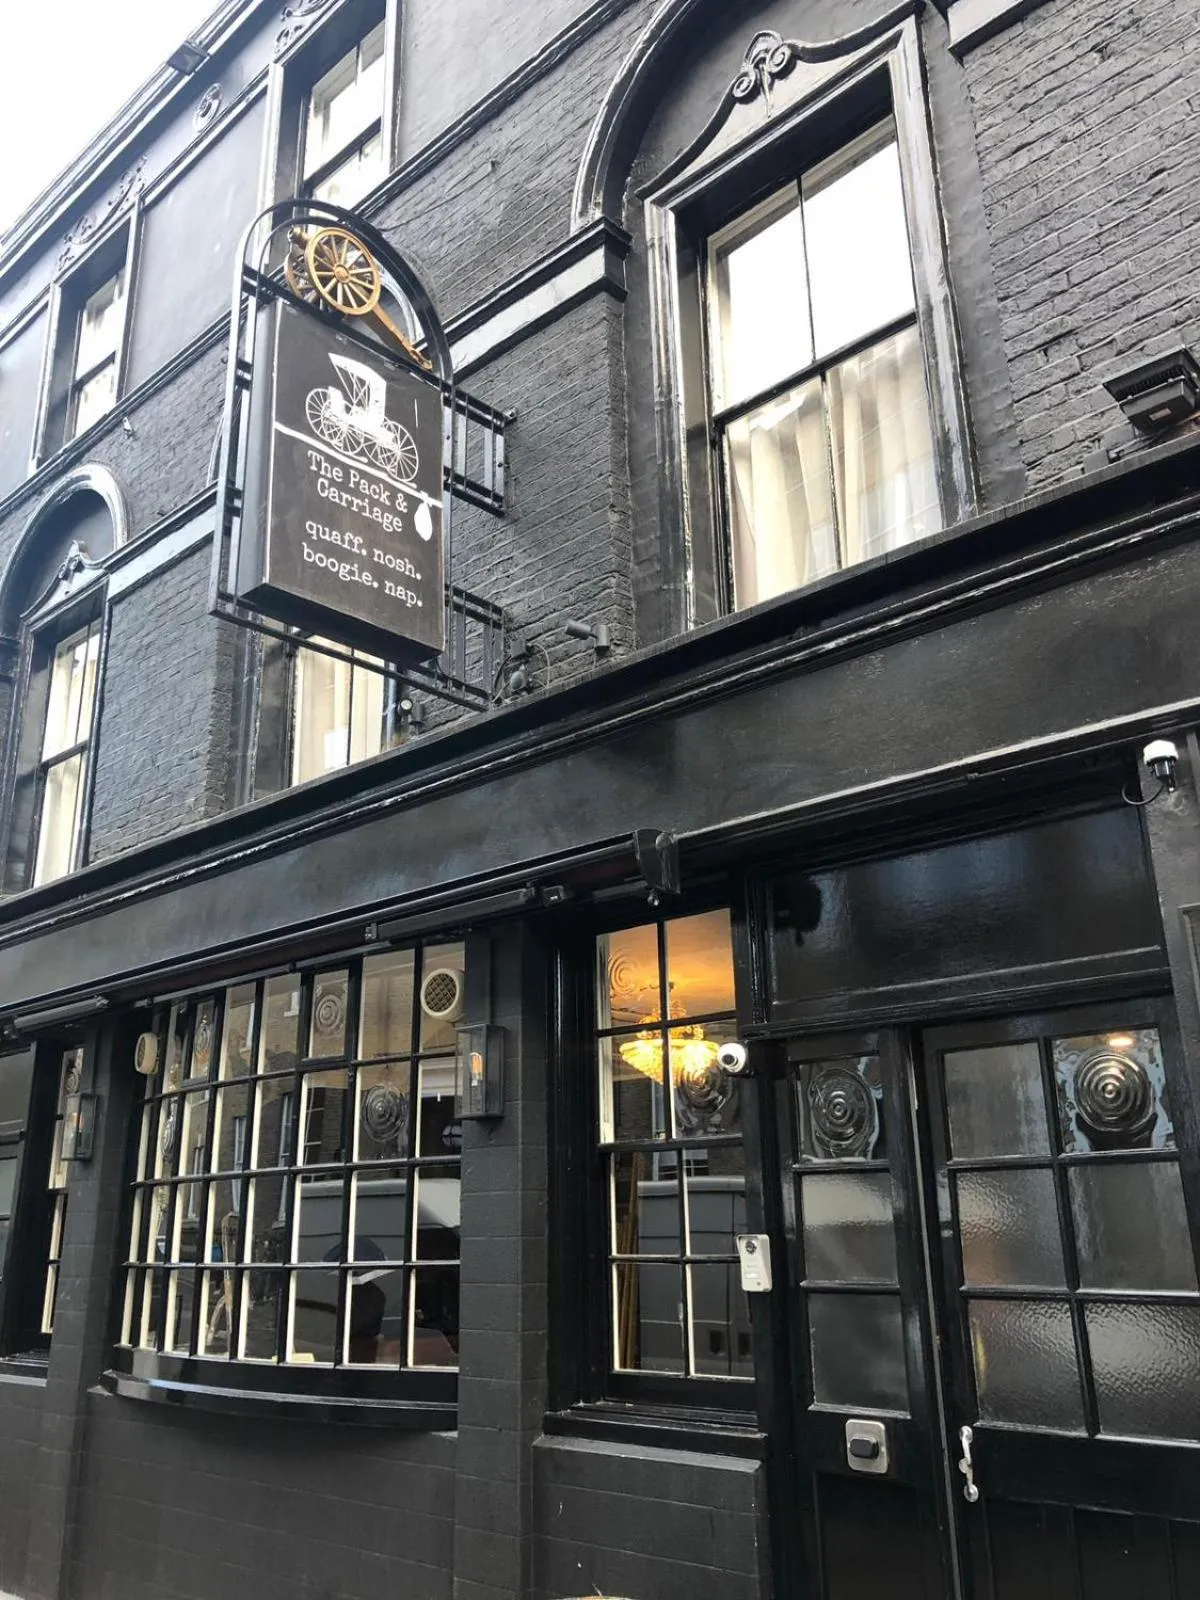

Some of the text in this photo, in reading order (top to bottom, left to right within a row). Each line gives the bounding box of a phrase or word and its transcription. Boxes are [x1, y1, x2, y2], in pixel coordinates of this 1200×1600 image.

[307, 450, 409, 514] The Pack &
[317, 478, 403, 532] Carriage
[302, 542, 424, 608] boogie. nap.
[305, 520, 422, 580] quaff. nosh.
